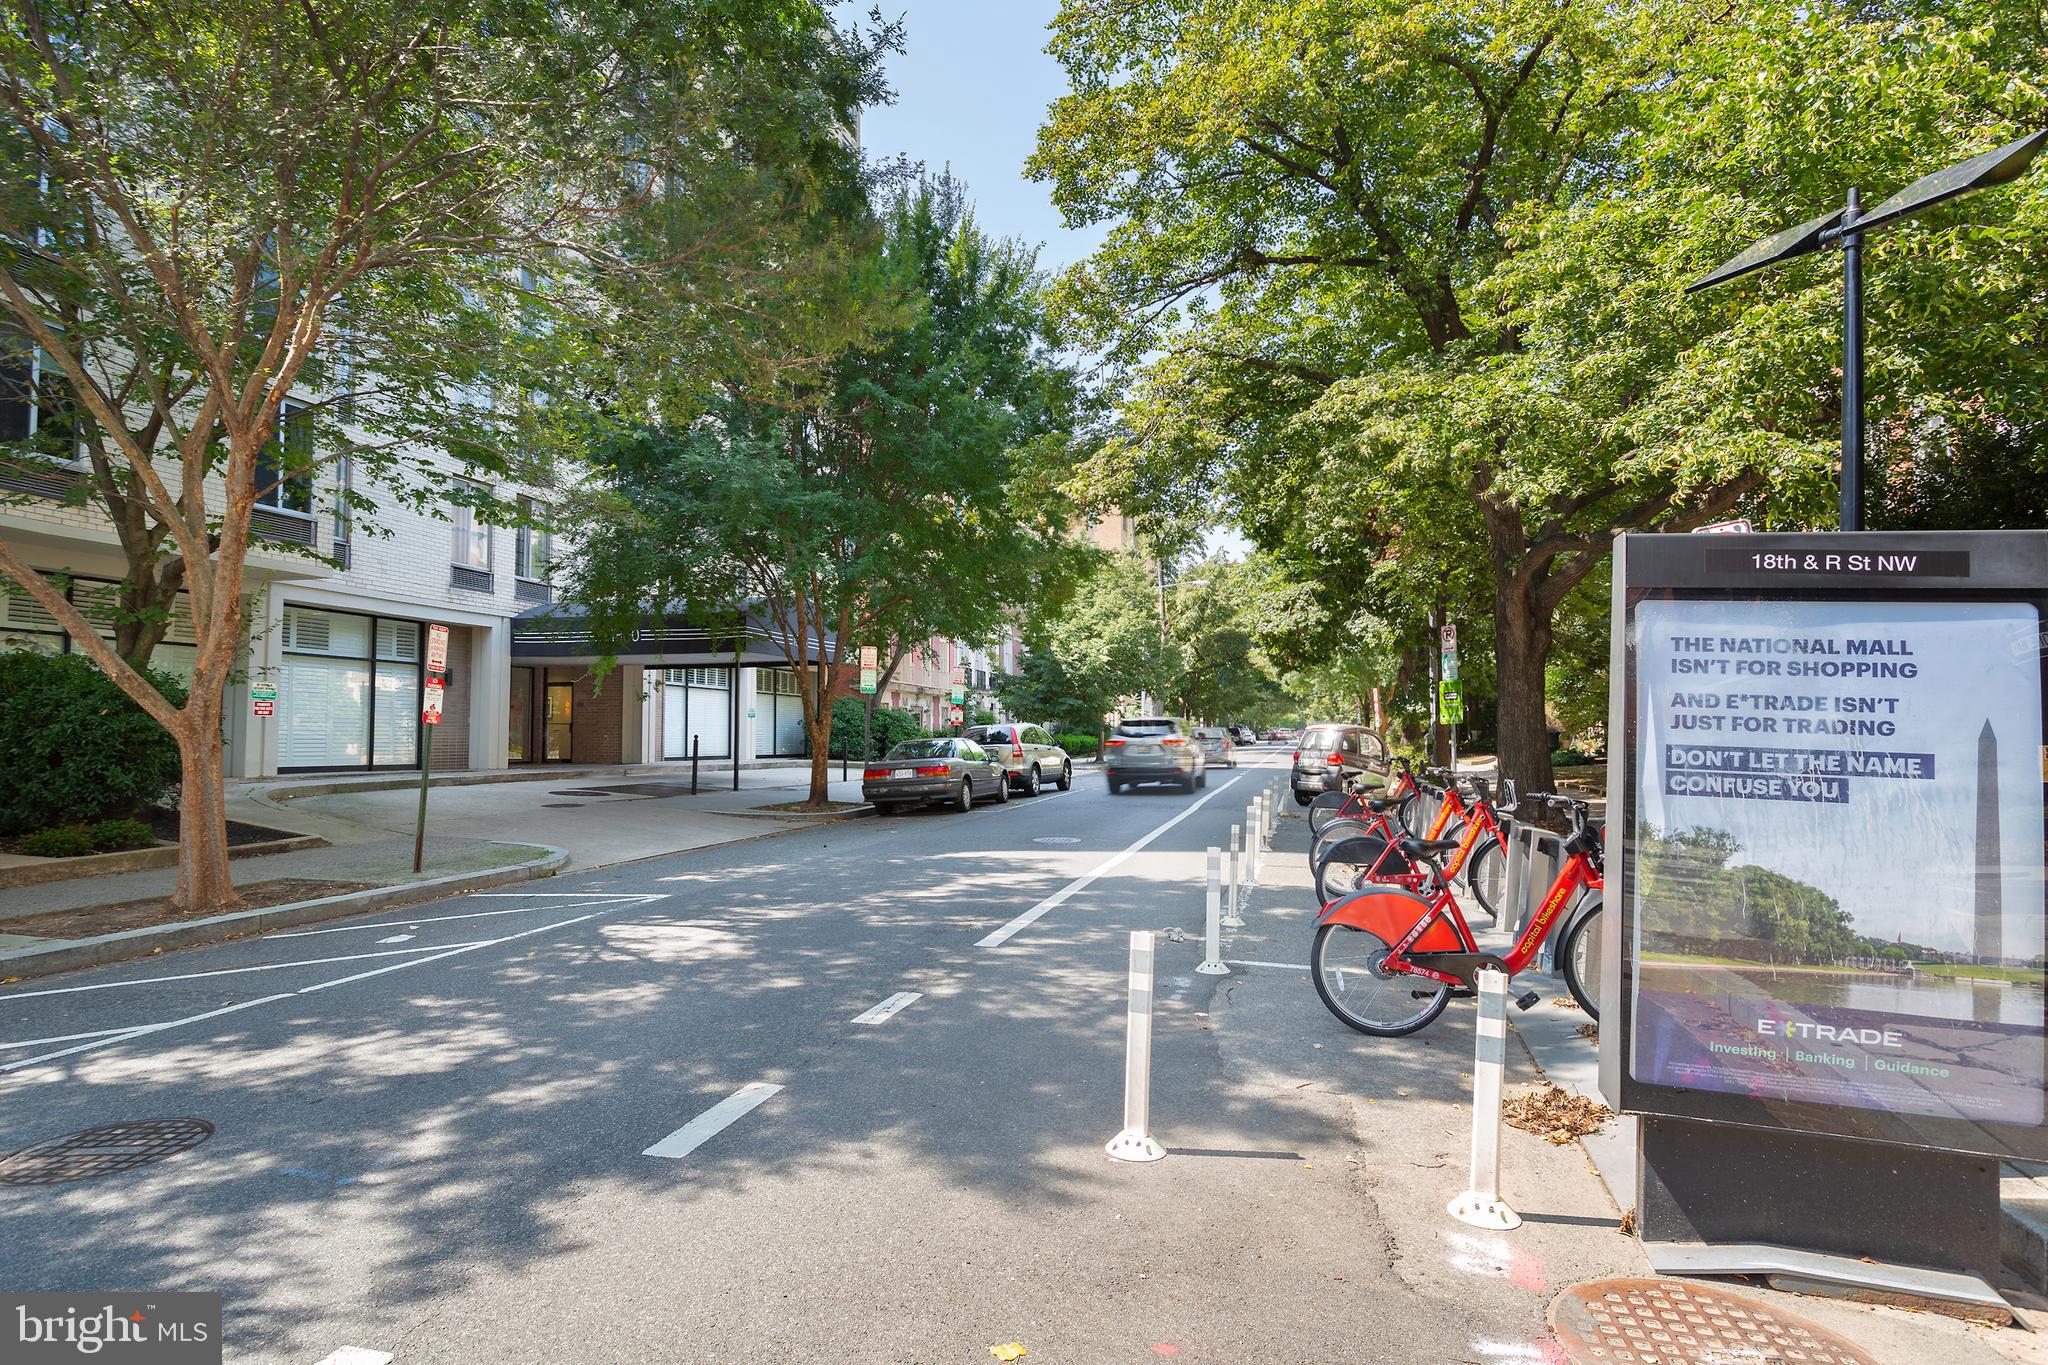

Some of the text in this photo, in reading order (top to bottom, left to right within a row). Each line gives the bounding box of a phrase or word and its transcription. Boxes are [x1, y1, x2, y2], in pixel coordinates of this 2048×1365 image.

[1751, 553, 1917, 571] 18th & R St NW
[1671, 636, 1914, 656] THE NATIONAL MALL
[1671, 658, 1918, 679] ISN'T FOR SHOPPING
[1671, 692, 1720, 709] AND
[1834, 696, 1899, 714] ISN'T
[1670, 714, 1896, 737] JUST FOR TRADING
[1671, 749, 1921, 776] DON'T LET THE NAME
[1670, 776, 1839, 799] CONFUSE YOU
[1461, 817, 1483, 849] bikeshare
[1521, 887, 1566, 954] capital bikeshare
[1409, 965, 1430, 977] 78574
[1709, 1040, 1949, 1079] Investing Banking Guidance
